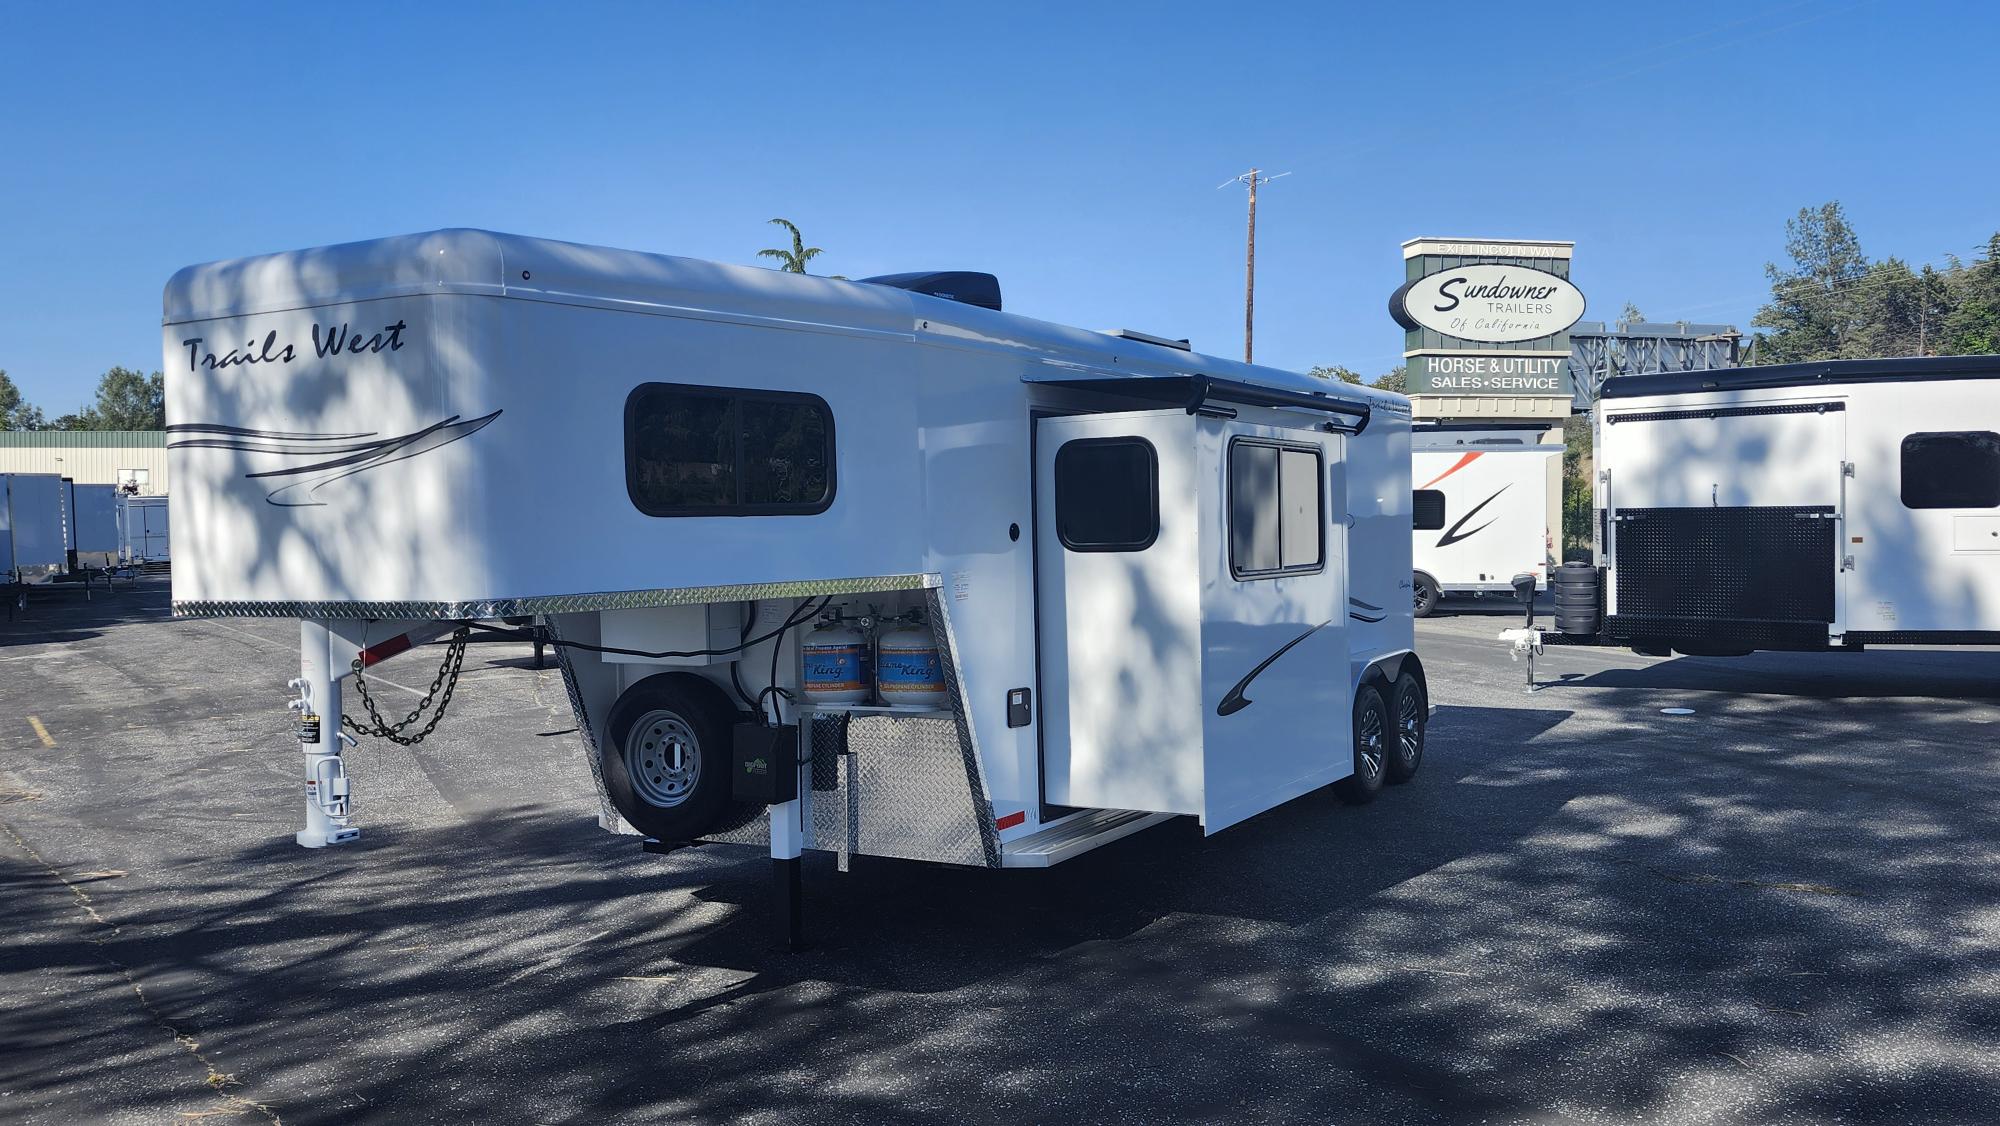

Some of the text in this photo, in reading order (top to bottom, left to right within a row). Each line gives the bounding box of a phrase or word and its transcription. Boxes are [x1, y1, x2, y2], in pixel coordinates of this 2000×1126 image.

[1437, 244, 1558, 257] EXIT LINCOLN WAY
[1434, 275, 1558, 312] Sundowner
[1488, 302, 1553, 314] TRAILERS
[1450, 317, 1541, 332] Of California
[183, 320, 407, 371] Trails West
[1428, 358, 1561, 374] HORSE & UTILITY
